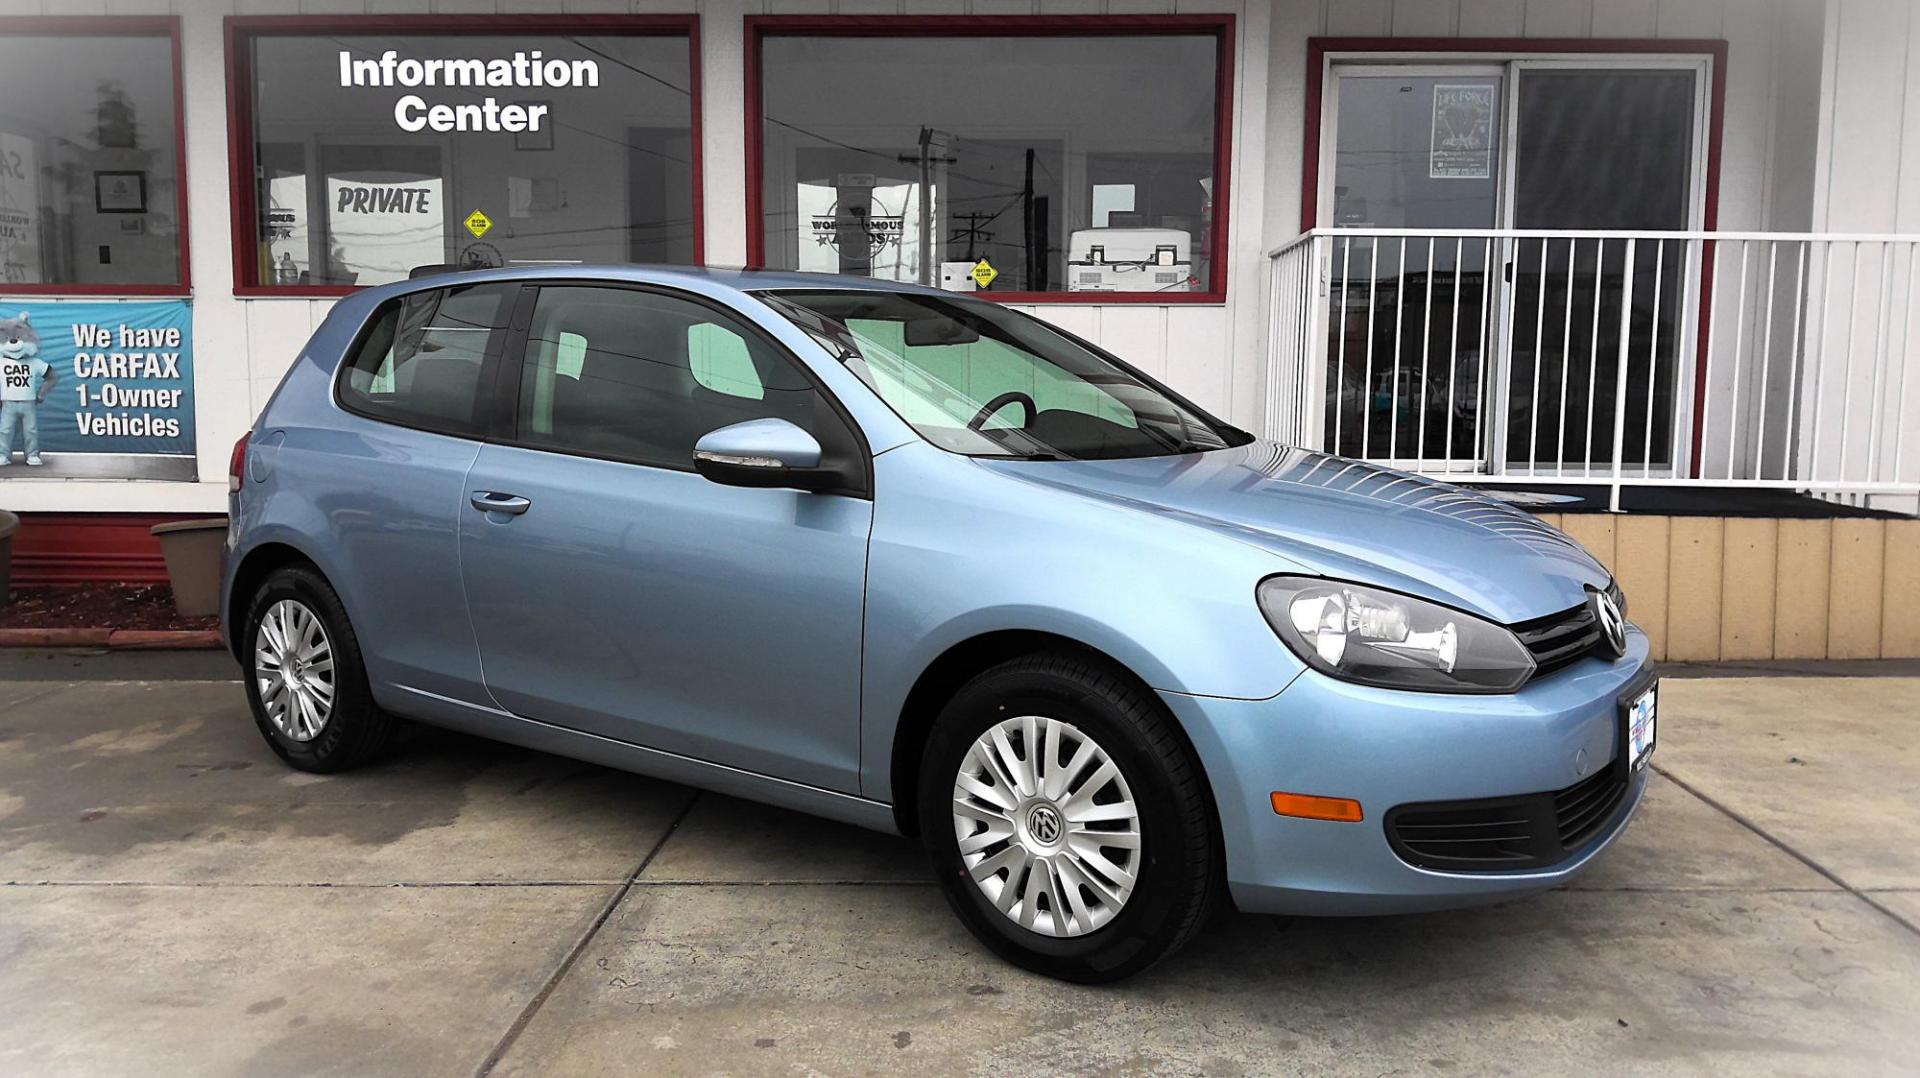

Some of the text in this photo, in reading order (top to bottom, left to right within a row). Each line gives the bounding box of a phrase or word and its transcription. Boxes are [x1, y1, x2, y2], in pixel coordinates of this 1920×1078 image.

[340, 51, 599, 87] Information
[395, 95, 547, 132] Center
[338, 187, 430, 214] PRIVATE
[72, 324, 180, 348] We have
[4, 364, 30, 375] CAR
[74, 352, 180, 378] CARFAX
[6, 376, 30, 387] FOX
[76, 384, 182, 408] 1-Owner
[76, 412, 180, 437] Vehicles
